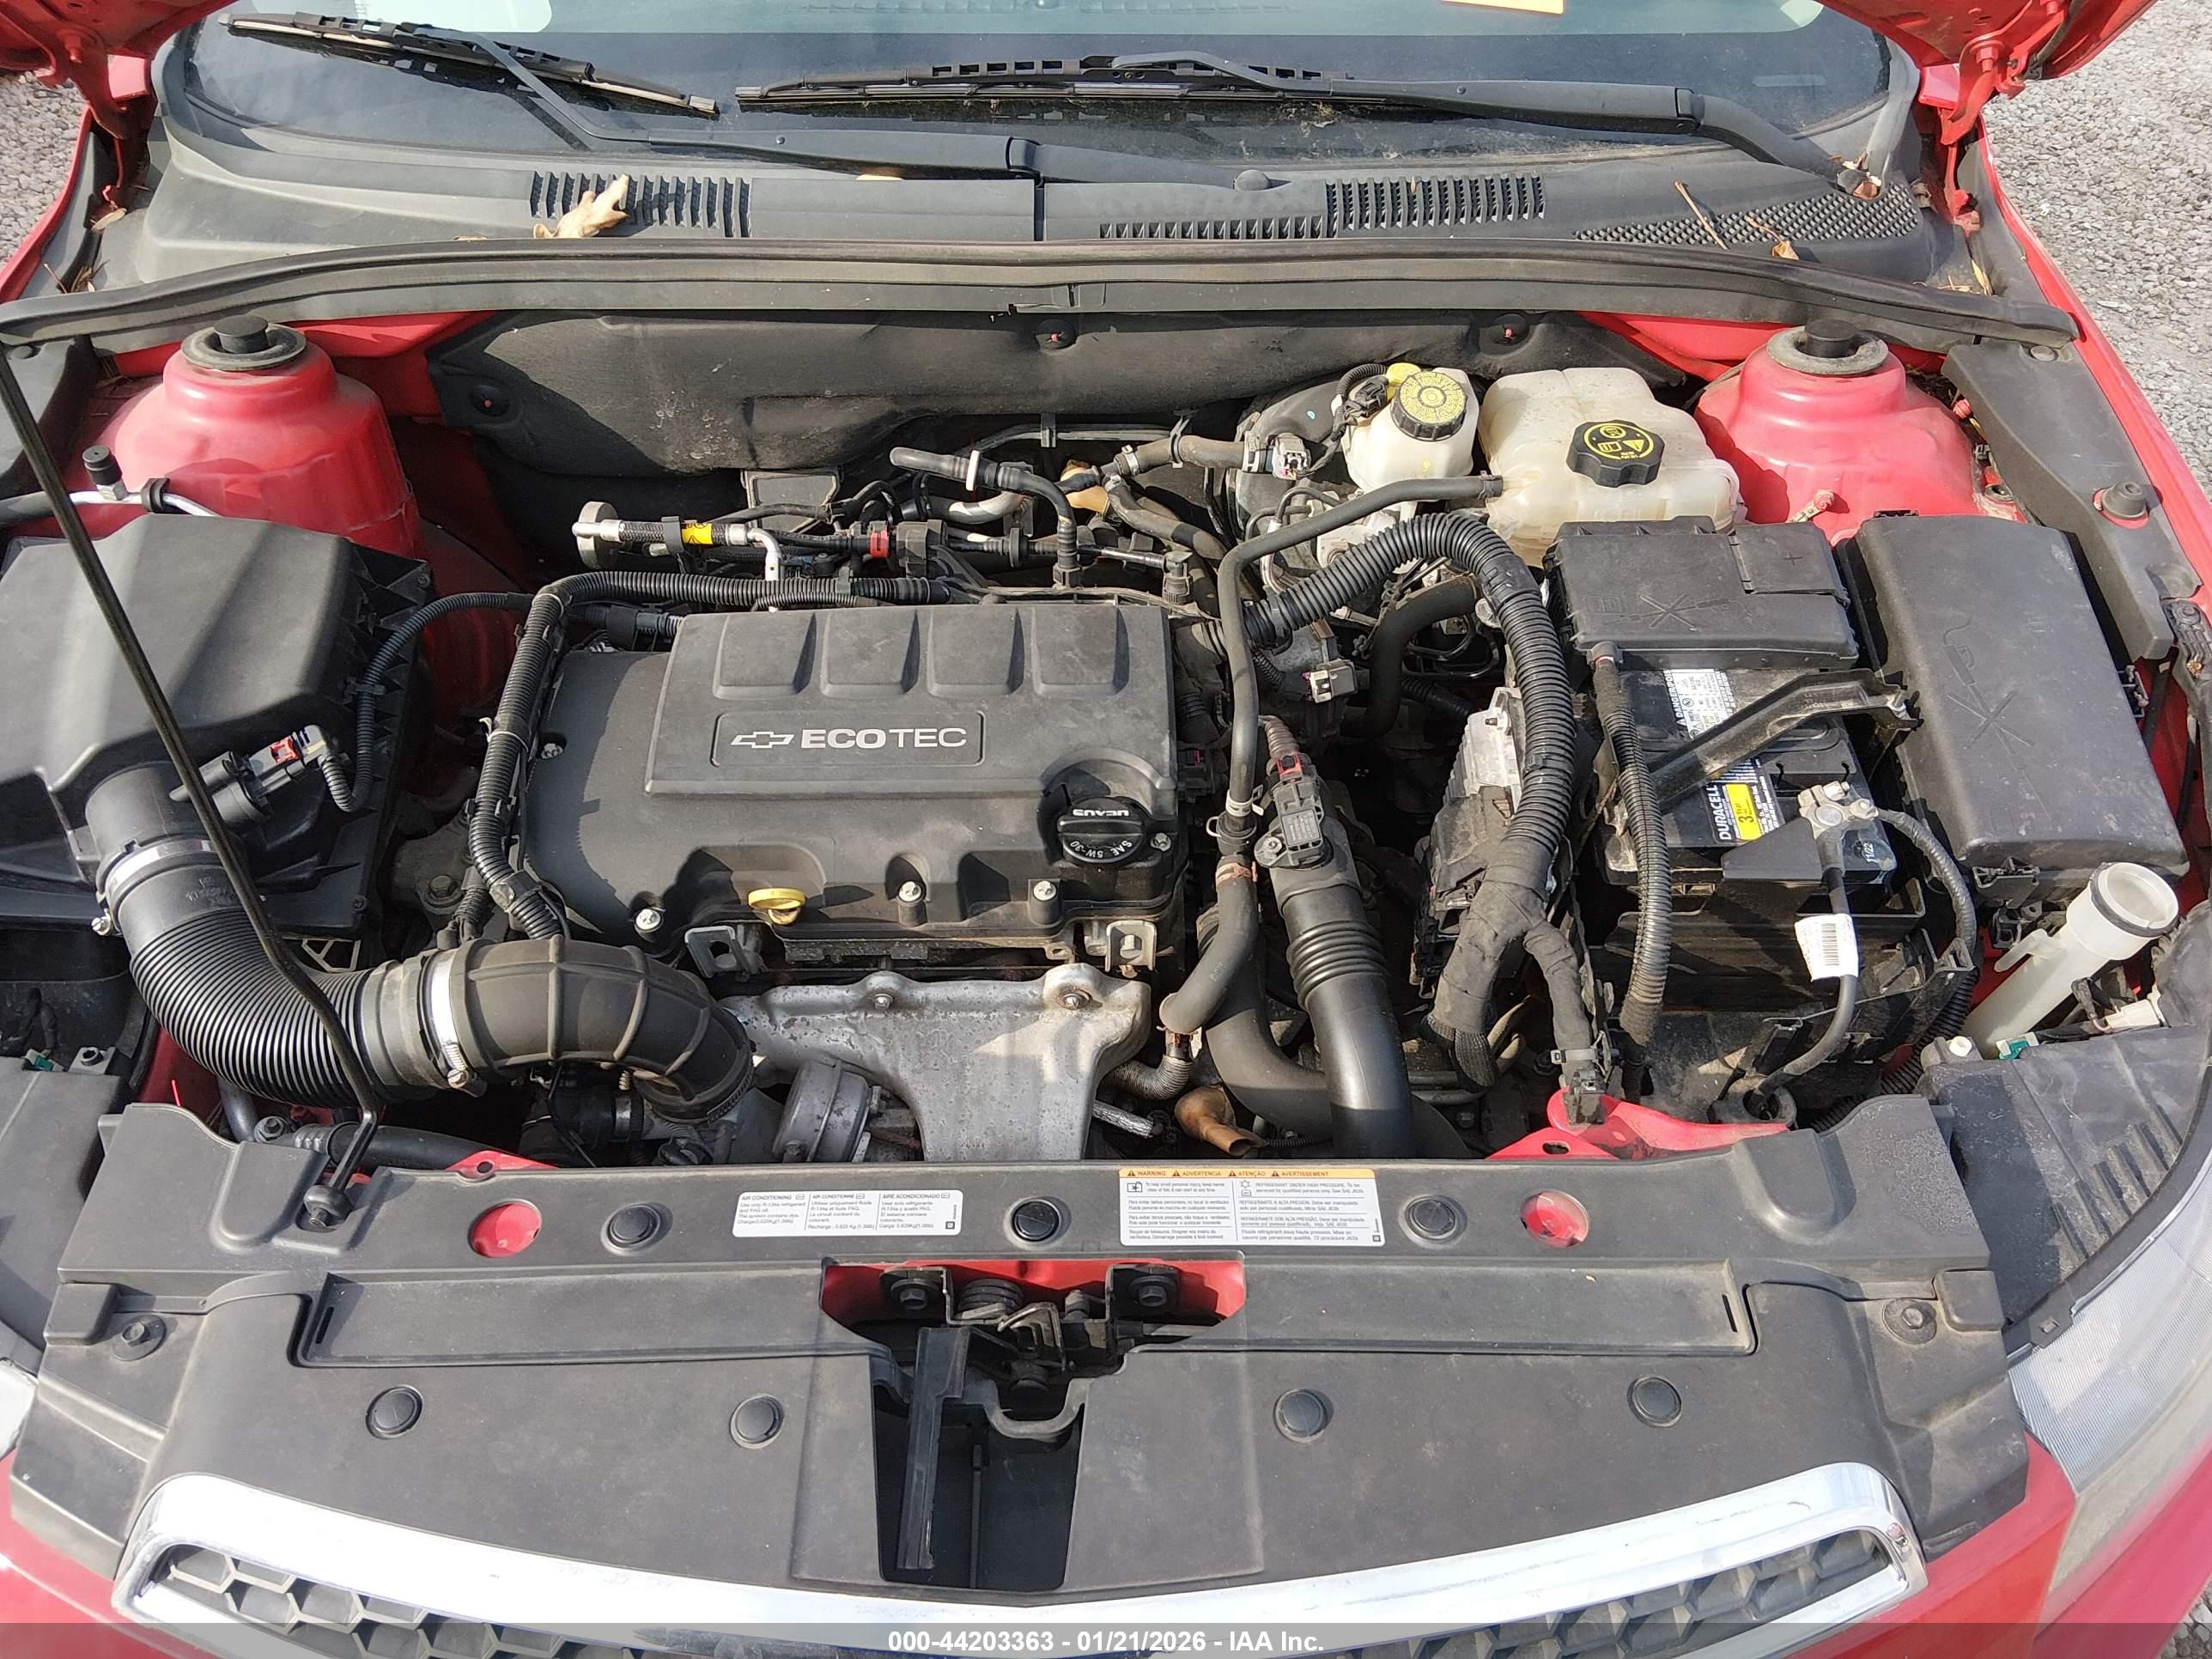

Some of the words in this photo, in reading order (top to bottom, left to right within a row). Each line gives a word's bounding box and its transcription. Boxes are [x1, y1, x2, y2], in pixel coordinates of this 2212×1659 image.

[801, 728, 967, 749] ECOTEC
[1706, 785, 1732, 840] DURACELL
[1738, 815, 1754, 823] 3
[1070, 841, 1104, 858] 5W-30
[1110, 840, 1133, 856] SAE
